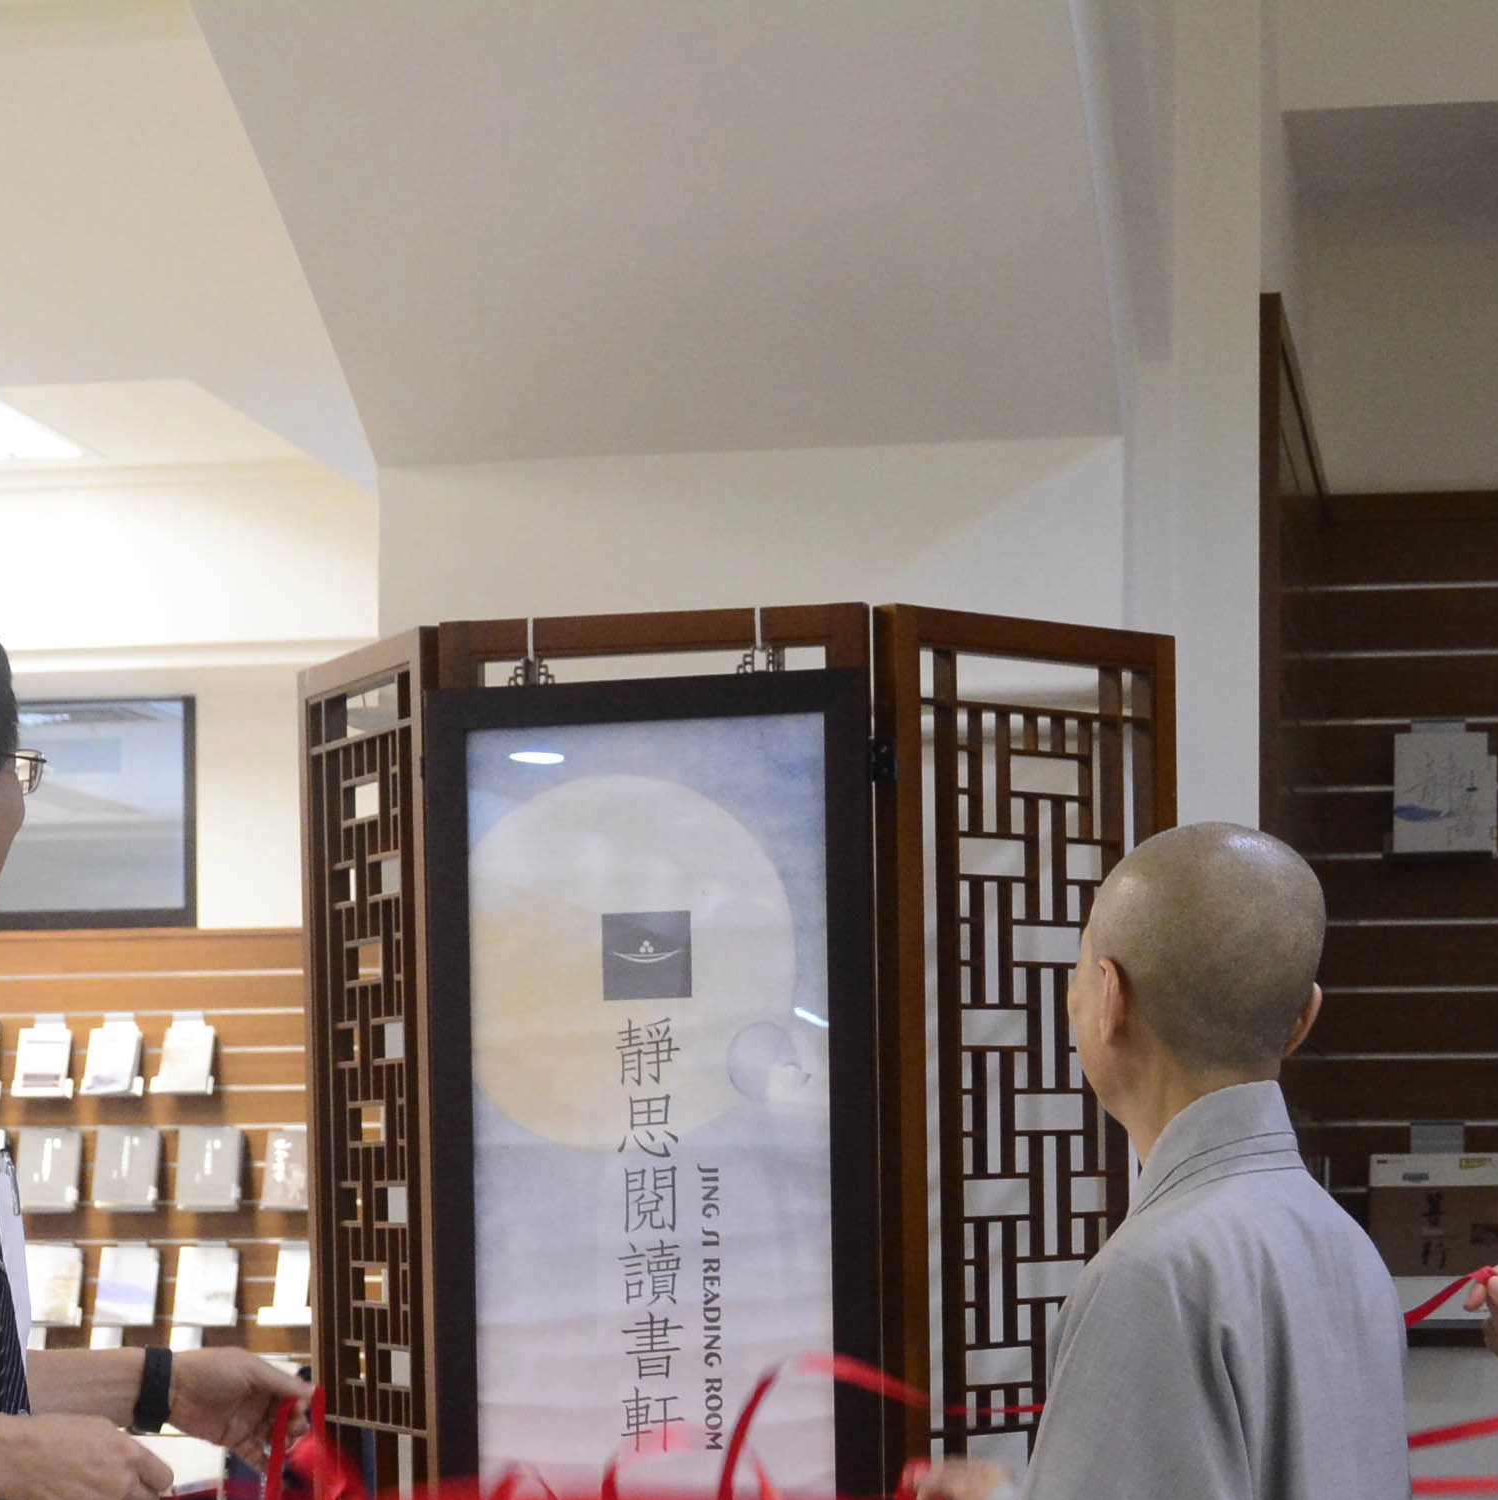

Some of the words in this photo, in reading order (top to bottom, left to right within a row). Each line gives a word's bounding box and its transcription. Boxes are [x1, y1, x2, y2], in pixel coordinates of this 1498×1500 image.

[697, 1163, 720, 1219] JING
[615, 1017, 685, 1453] 靜思閱讀書軒
[701, 1226, 720, 1247] SI
[702, 1258, 722, 1368] READING
[705, 1378, 723, 1450] ROOM
